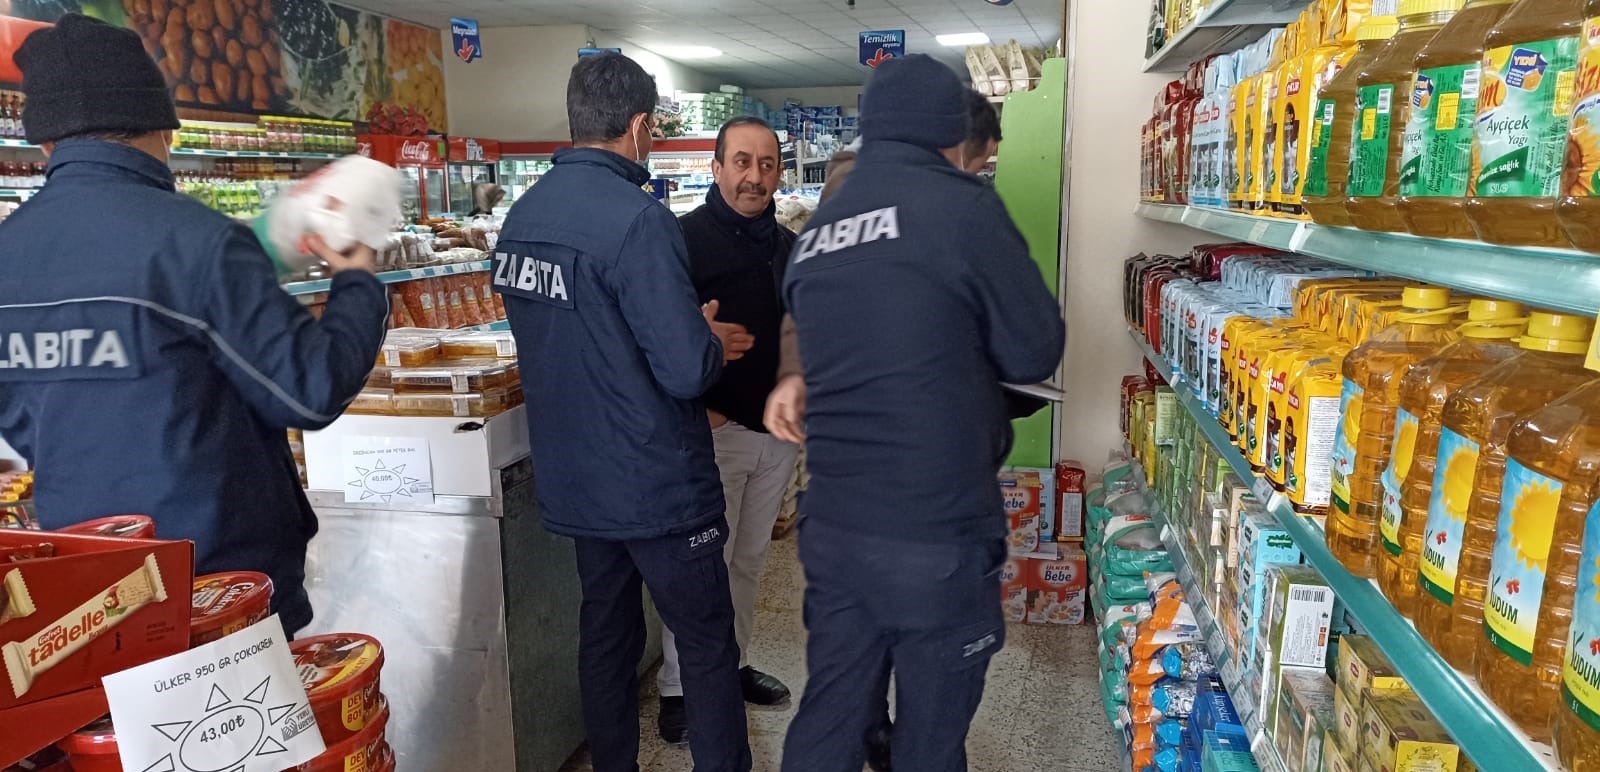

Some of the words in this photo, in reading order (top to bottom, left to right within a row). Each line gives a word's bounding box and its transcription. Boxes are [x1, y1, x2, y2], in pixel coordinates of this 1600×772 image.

[864, 33, 897, 43] Temizlik
[1487, 115, 1529, 135] Ayçiçek
[1508, 135, 1528, 147] Yağı
[1499, 158, 1520, 172] sağlık
[793, 206, 899, 264] ZABITA
[494, 252, 568, 300] ZABITA
[689, 528, 720, 547] ZABITA
[1044, 570, 1072, 582] Bebe
[1046, 563, 1070, 571] ÜLKER
[28, 610, 105, 667] tadelle
[154, 672, 192, 693] ÜLKER
[195, 663, 215, 678] 950
[218, 656, 231, 670] GR
[233, 637, 274, 664] ÇOKOKREM
[200, 714, 245, 745] 43,00₺
